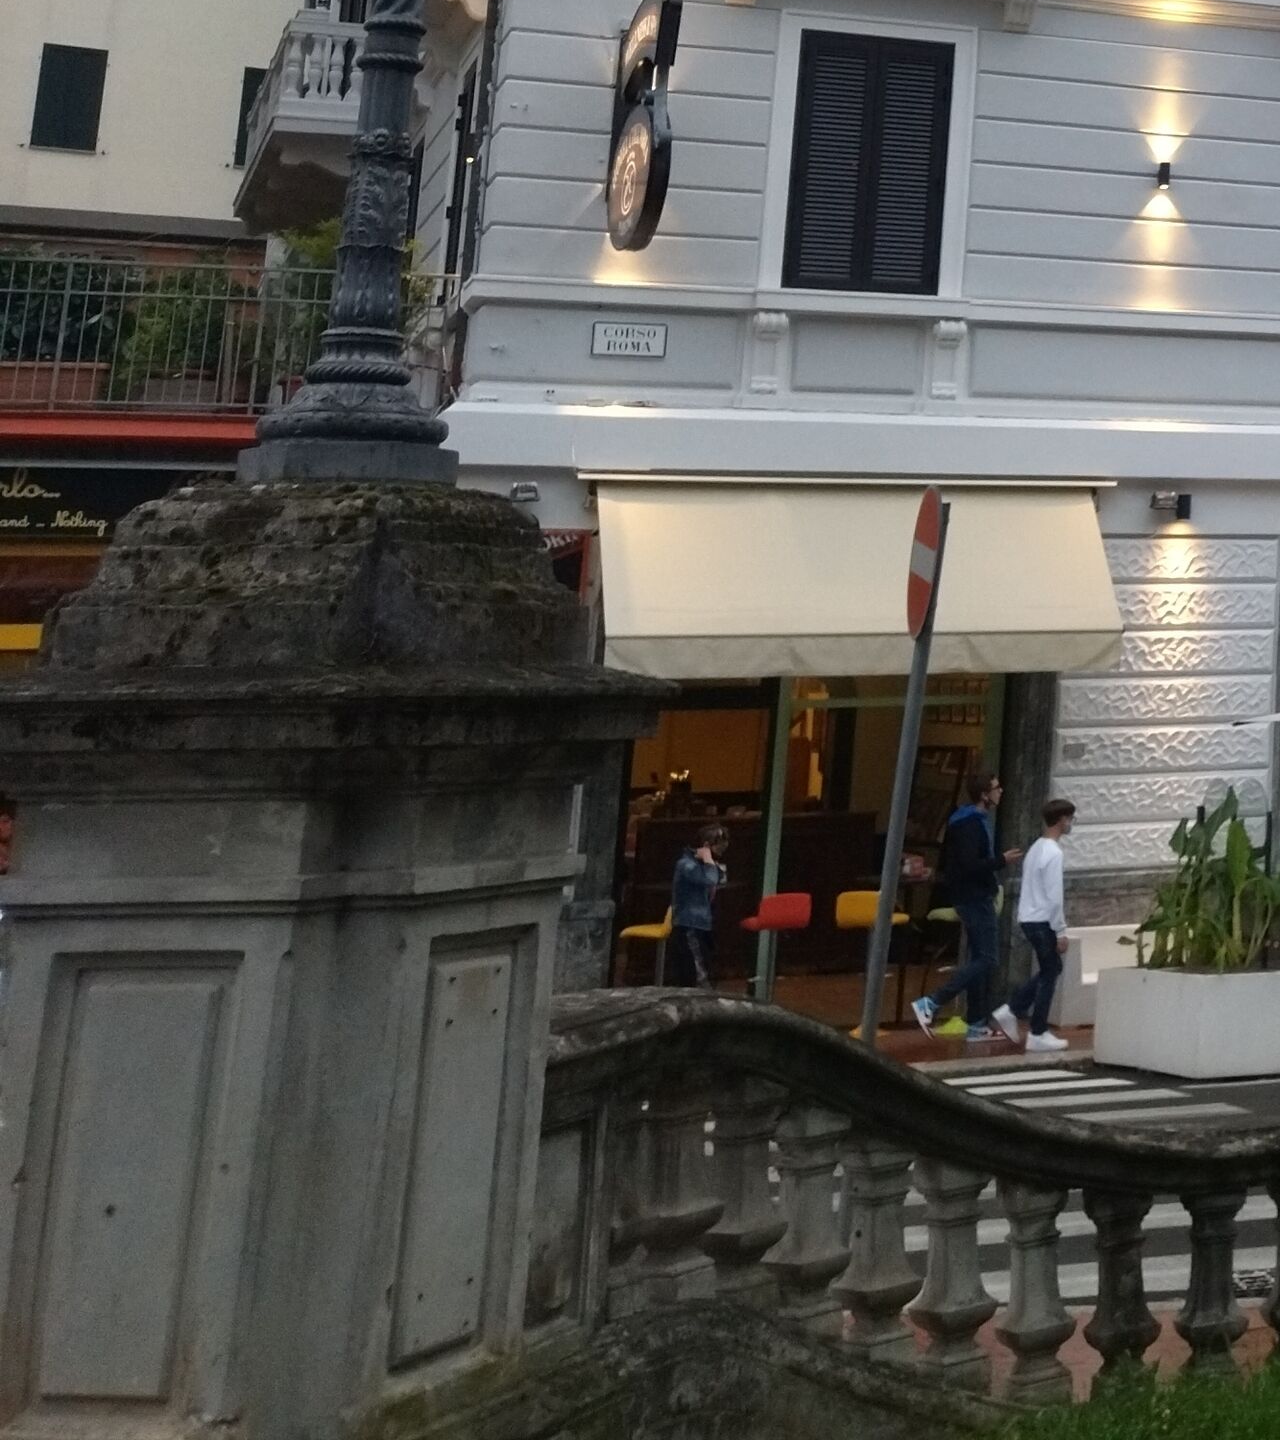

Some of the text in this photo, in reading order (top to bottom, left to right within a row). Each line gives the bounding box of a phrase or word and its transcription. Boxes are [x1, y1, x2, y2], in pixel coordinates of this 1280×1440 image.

[603, 327, 657, 339] CORSO
[607, 340, 651, 352] ROMA
[50, 509, 108, 537] Nothing
